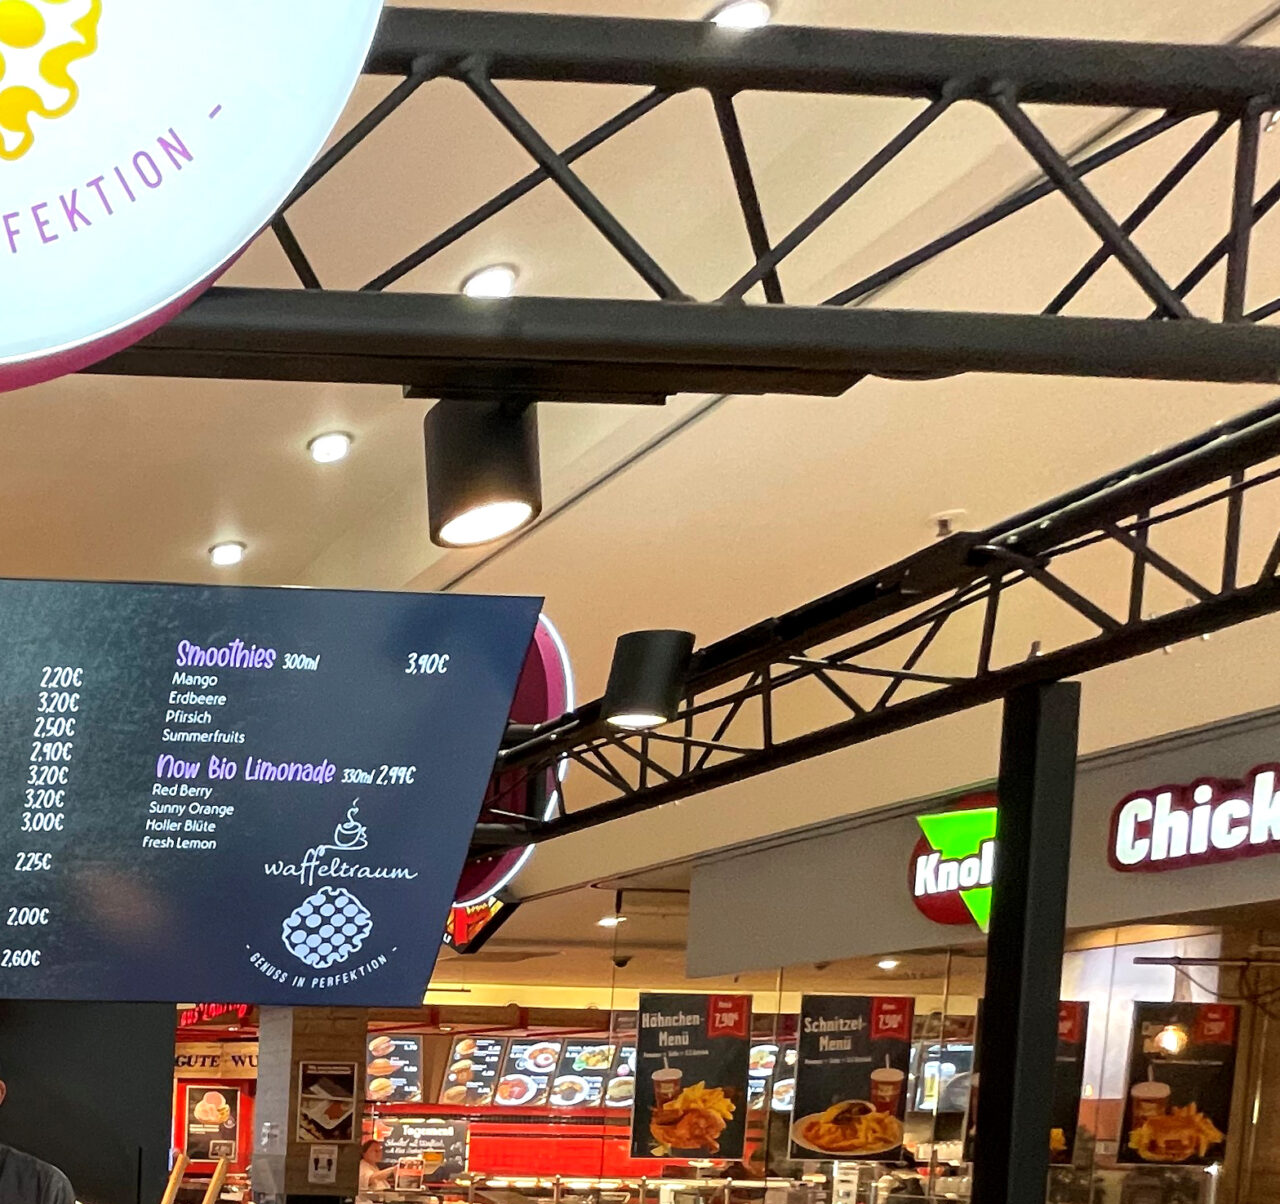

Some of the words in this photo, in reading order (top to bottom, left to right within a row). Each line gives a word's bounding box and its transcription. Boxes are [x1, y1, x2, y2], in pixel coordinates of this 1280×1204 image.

[176, 638, 277, 670] Smoothies
[405, 652, 450, 675] 3,90€
[171, 671, 218, 689] Mango
[168, 691, 227, 706] Erdbeere
[33, 716, 76, 738] 2,50€
[165, 709, 212, 725] Pfirsich
[161, 728, 246, 744] Summerfruits
[30, 740, 74, 762] 2,90€
[208, 754, 237, 780] Bio
[244, 755, 337, 784] Limonade
[152, 783, 179, 797] Red
[180, 784, 213, 799] Berry
[149, 801, 187, 818] Sunny
[189, 803, 235, 818] Orange
[1115, 770, 1280, 865] Chick
[20, 812, 65, 833] 3,00€
[145, 818, 182, 833] Holler
[184, 818, 216, 833] Blüte
[142, 836, 174, 849] Fresh
[175, 836, 217, 850] Lemon
[264, 846, 418, 887] waffeltraum
[6, 906, 50, 927] 2,00€
[0, 948, 42, 968] 2,60€
[249, 951, 287, 984] GENUSS
[292, 975, 305, 988] IN
[311, 953, 388, 988] PERFEKTION
[176, 1054, 221, 1068] GUTE
